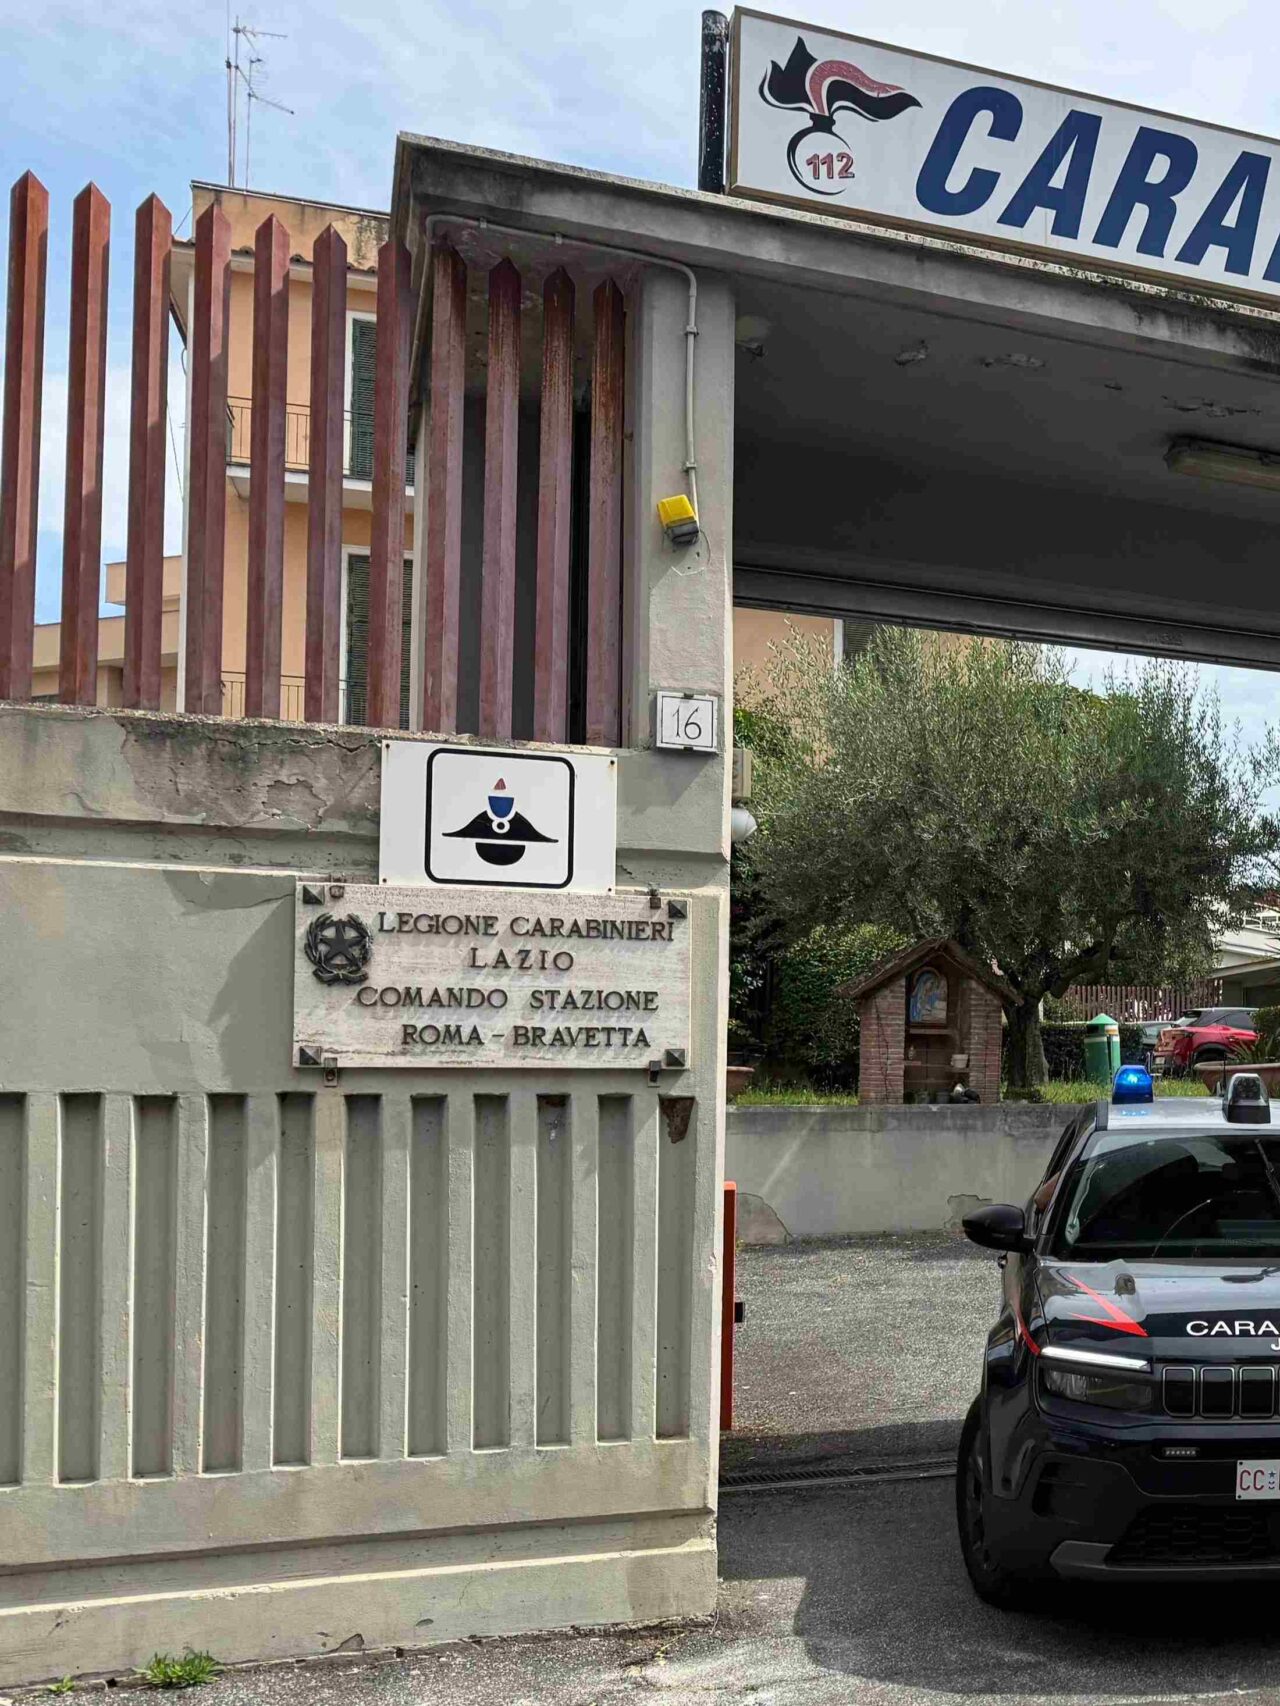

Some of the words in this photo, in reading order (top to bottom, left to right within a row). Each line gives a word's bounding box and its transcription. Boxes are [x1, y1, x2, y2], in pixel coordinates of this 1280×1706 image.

[806, 152, 855, 180] 112
[672, 706, 702, 740] 16
[378, 912, 499, 937] LEGIONE
[510, 917, 675, 942] CARABINIERI
[470, 947, 575, 972] LAZIO
[356, 986, 508, 1009] COMANDO
[529, 990, 660, 1012] STAZIONE
[402, 1024, 484, 1046] ROMA
[513, 1026, 652, 1048] BRAVETTA
